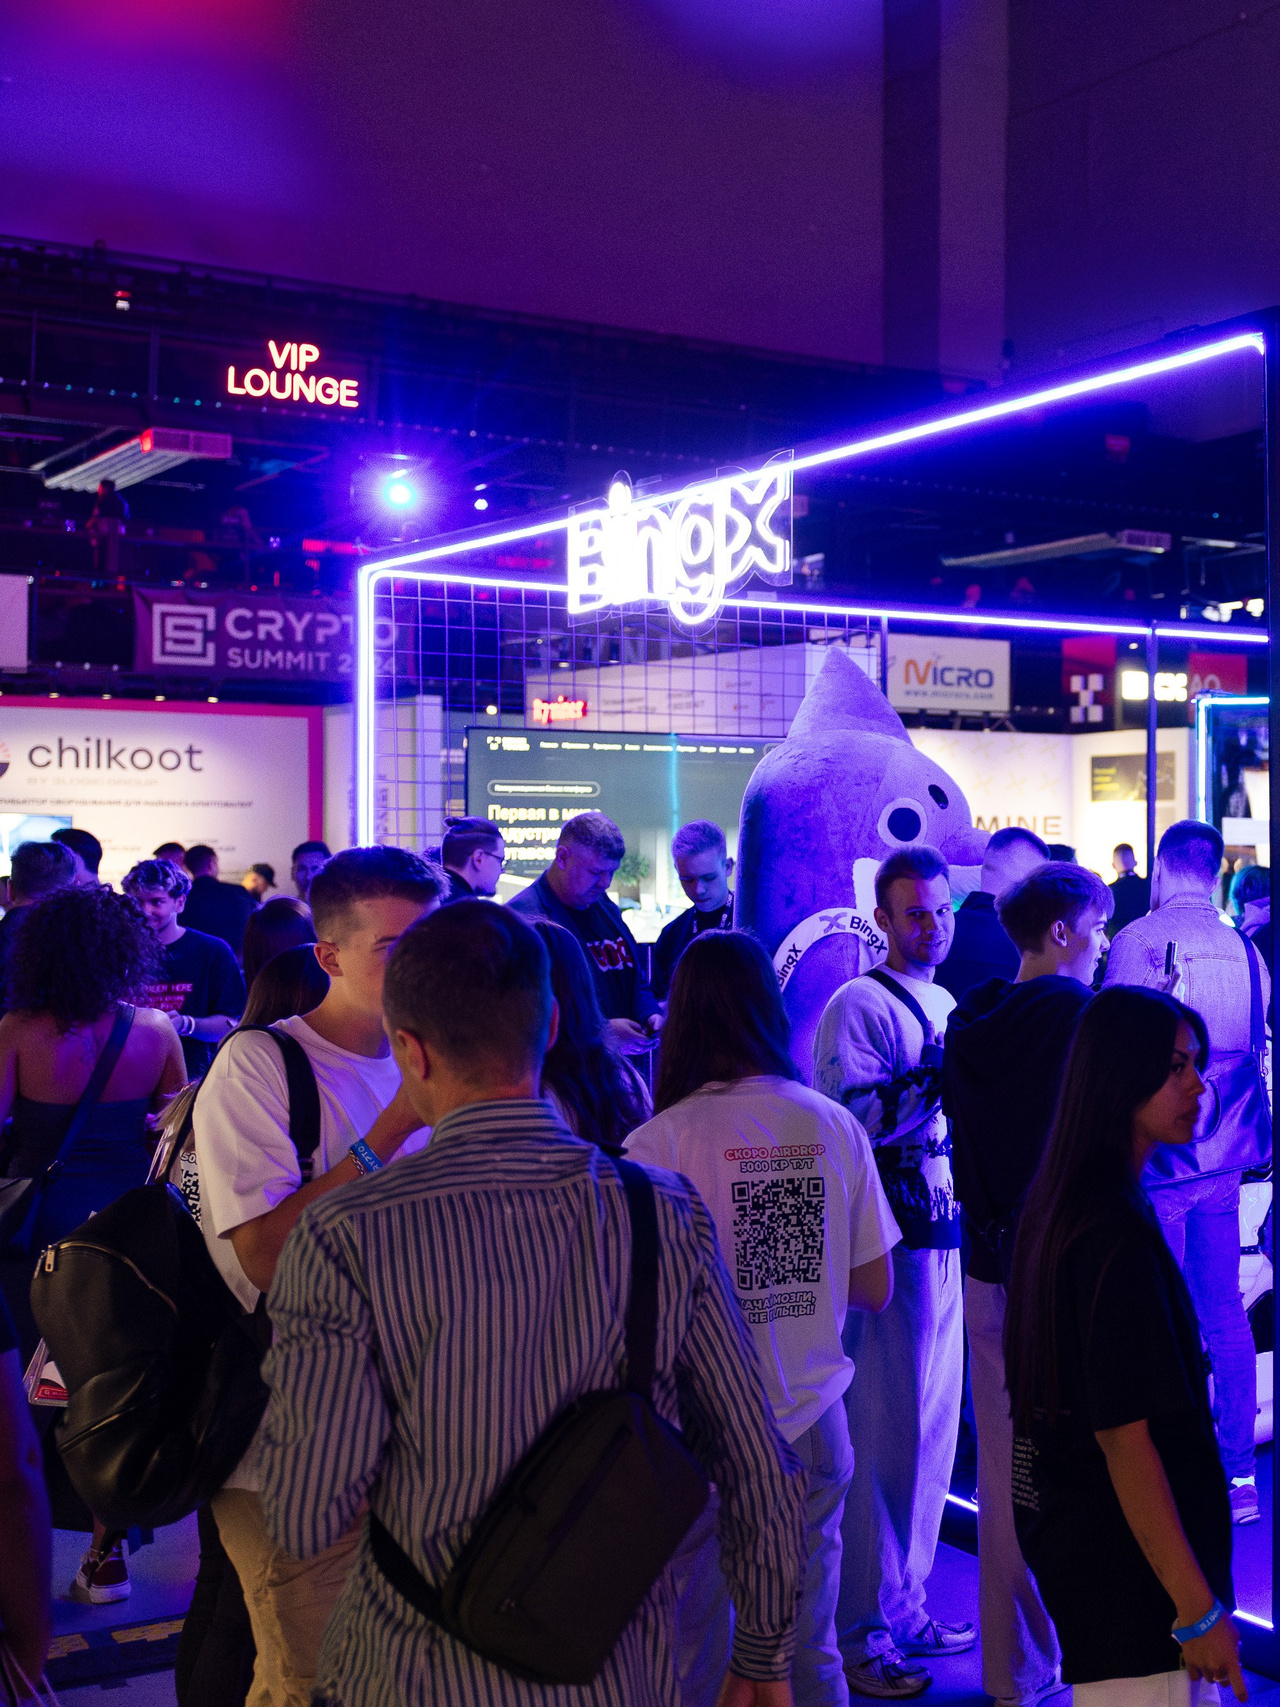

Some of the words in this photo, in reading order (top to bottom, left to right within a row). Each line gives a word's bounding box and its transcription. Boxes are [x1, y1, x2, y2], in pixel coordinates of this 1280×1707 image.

[268, 339, 320, 372] VIP
[227, 365, 359, 408] LOUNGE
[567, 462, 790, 625] BingX
[227, 647, 331, 671] SUMMIT
[337, 653, 399, 675] 224
[28, 737, 203, 771] chilkoot
[487, 804, 546, 824] Первая
[849, 915, 887, 955] BingX
[724, 1146, 769, 1161] СКОРО
[770, 1144, 826, 1158] AIRDROP
[741, 1161, 770, 1173] 5000
[749, 1311, 768, 1324] НЕ
